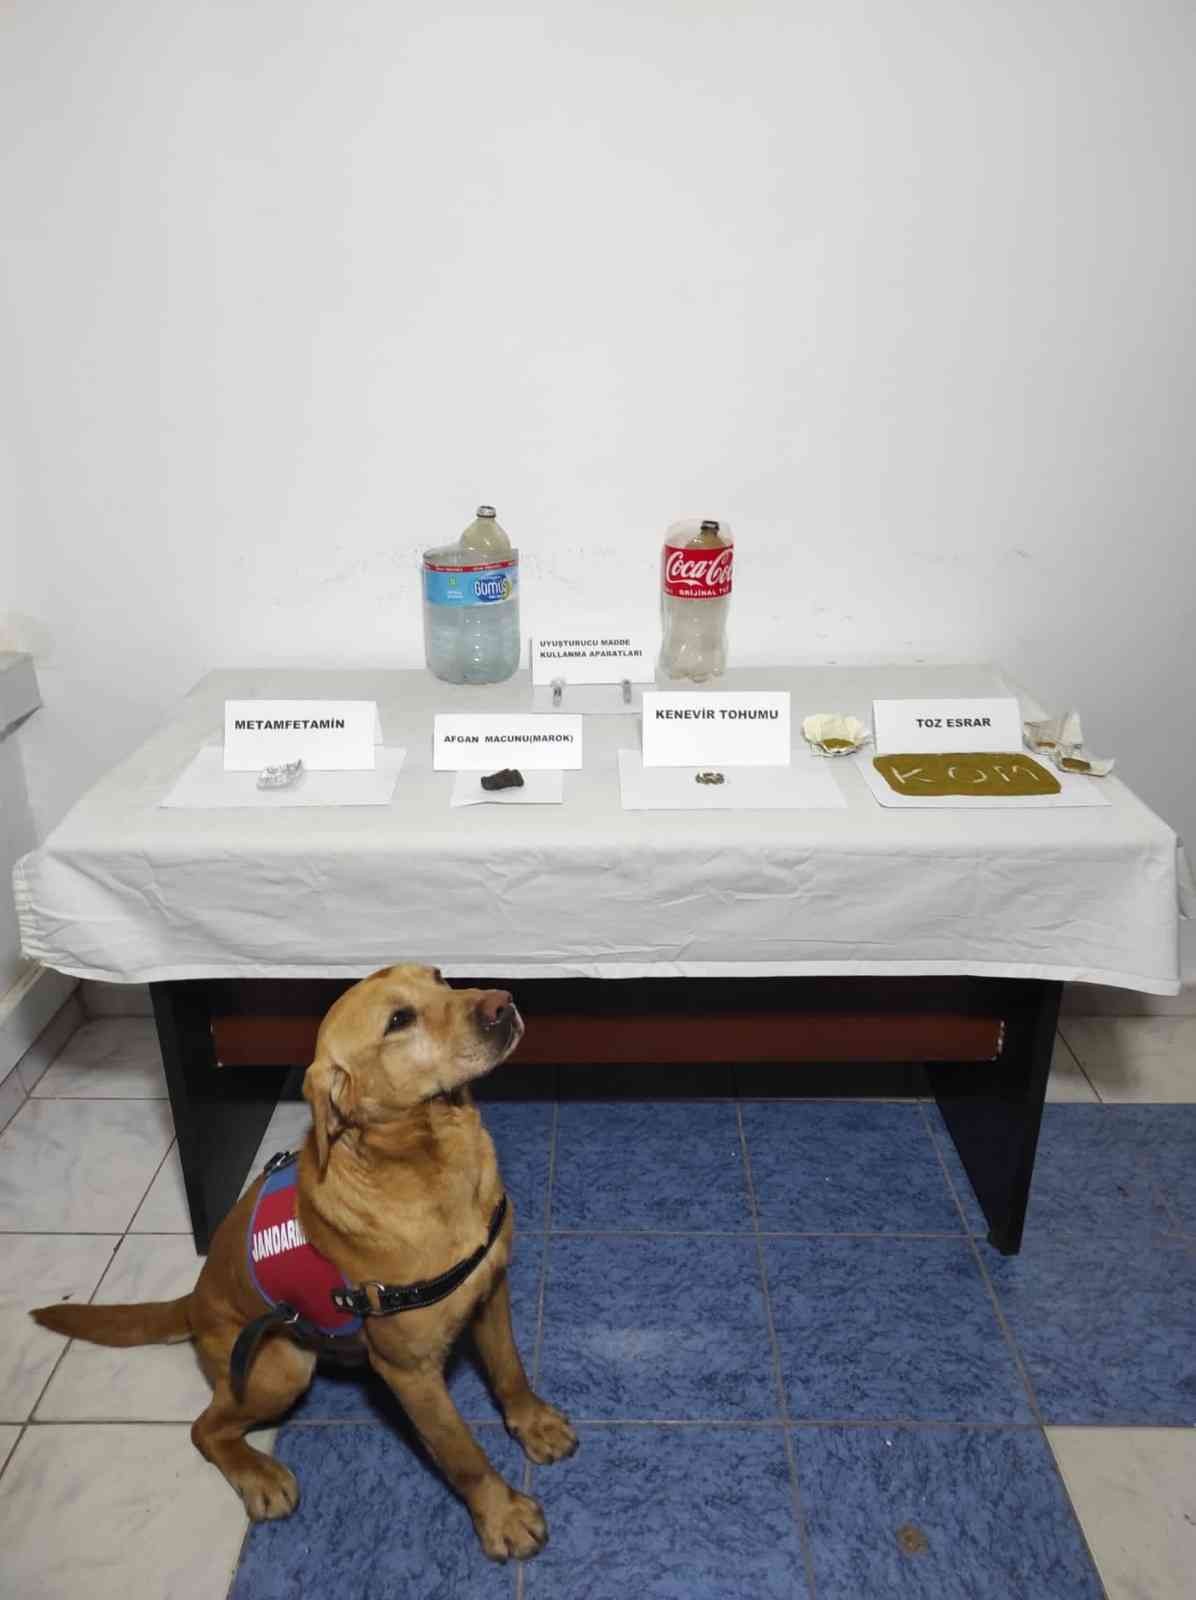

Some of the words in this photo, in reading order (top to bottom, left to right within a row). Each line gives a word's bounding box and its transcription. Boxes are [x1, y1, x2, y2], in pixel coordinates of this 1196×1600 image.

[539, 639, 599, 648] UYUŞTURUCU
[539, 650, 587, 658] KULLANMA
[655, 707, 715, 720] KENEVİR
[719, 709, 779, 720] TOHUMU
[234, 717, 346, 730] METAMFETAMİN
[916, 718, 942, 729] TOZ
[946, 717, 992, 728] ESRAR
[444, 735, 479, 743] AFGAN
[484, 734, 574, 744] MACUNU(MAROK)
[891, 764, 1040, 785] KOM
[252, 1218, 308, 1263] JANDARM
